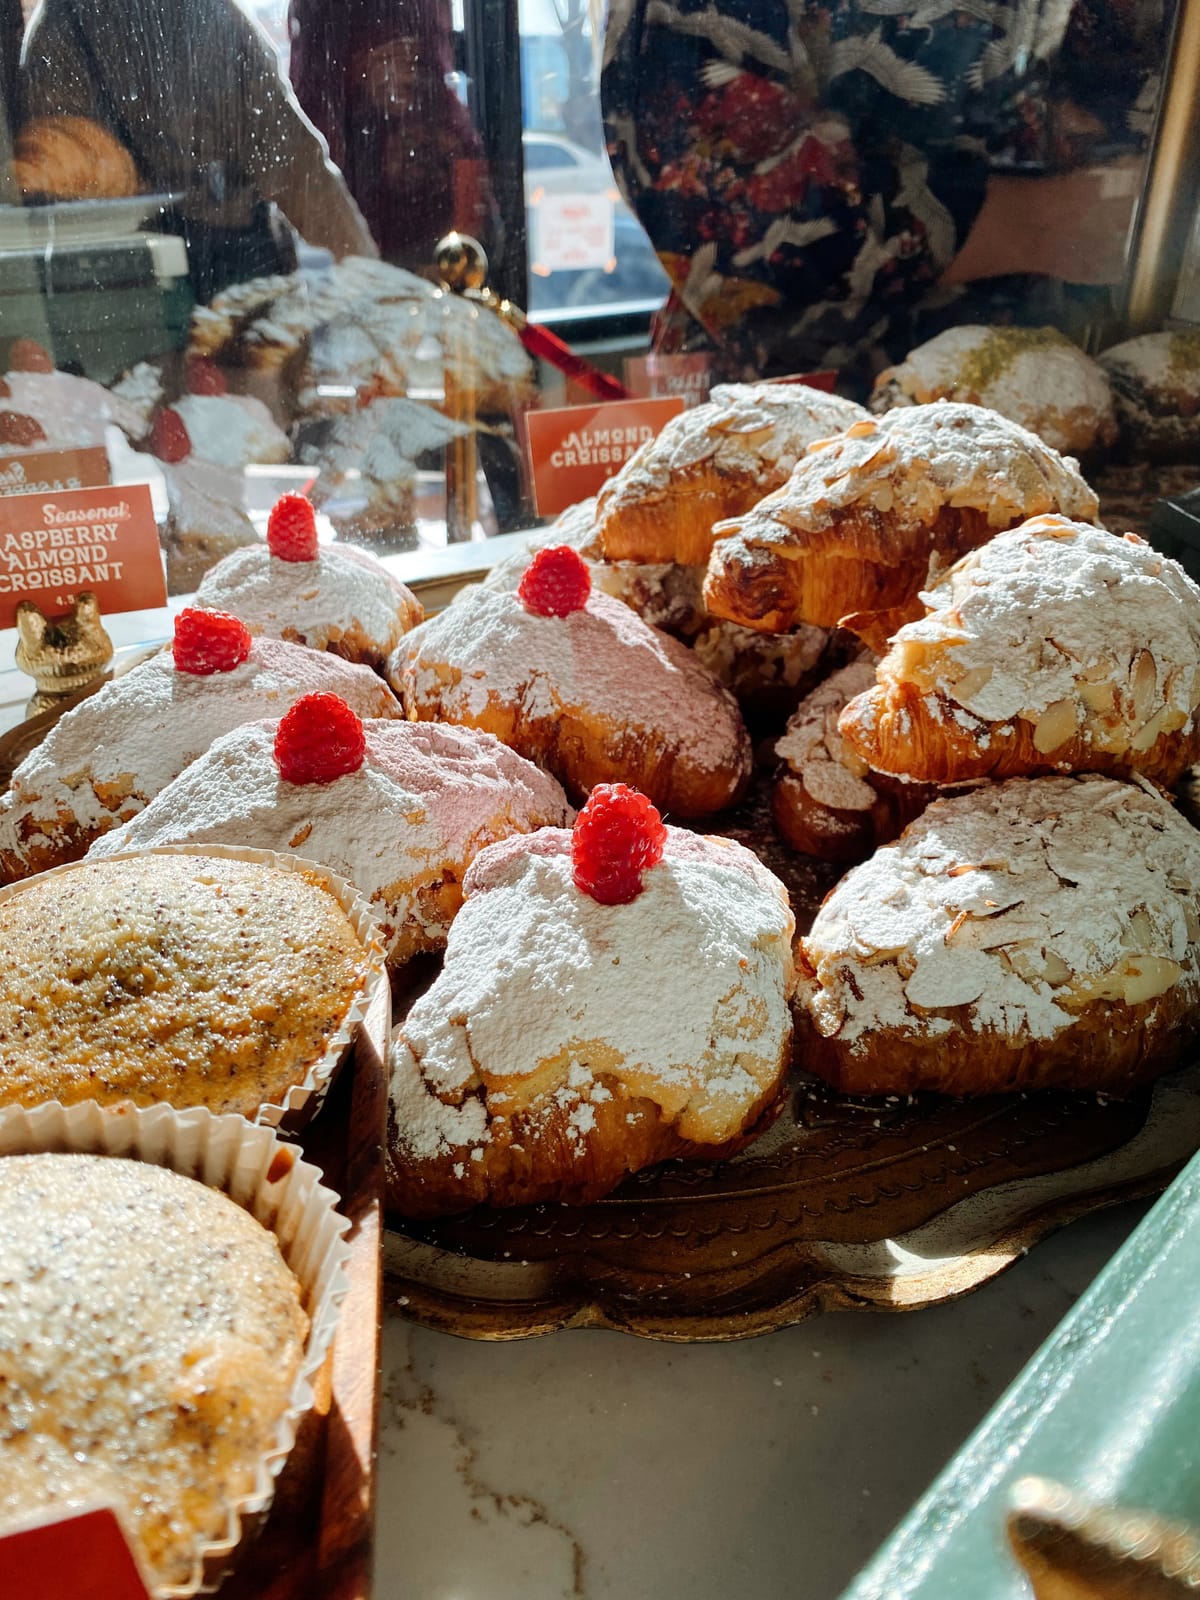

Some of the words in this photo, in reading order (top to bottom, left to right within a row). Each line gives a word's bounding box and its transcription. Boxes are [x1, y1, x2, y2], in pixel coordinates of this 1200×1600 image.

[562, 425, 653, 449] ALMOND
[550, 445, 636, 468] CROISSA
[42, 501, 128, 525] Seasonal
[0, 523, 118, 557] ASPBERRY
[8, 545, 108, 572] ALMOND
[0, 562, 123, 592] CROISSANT
